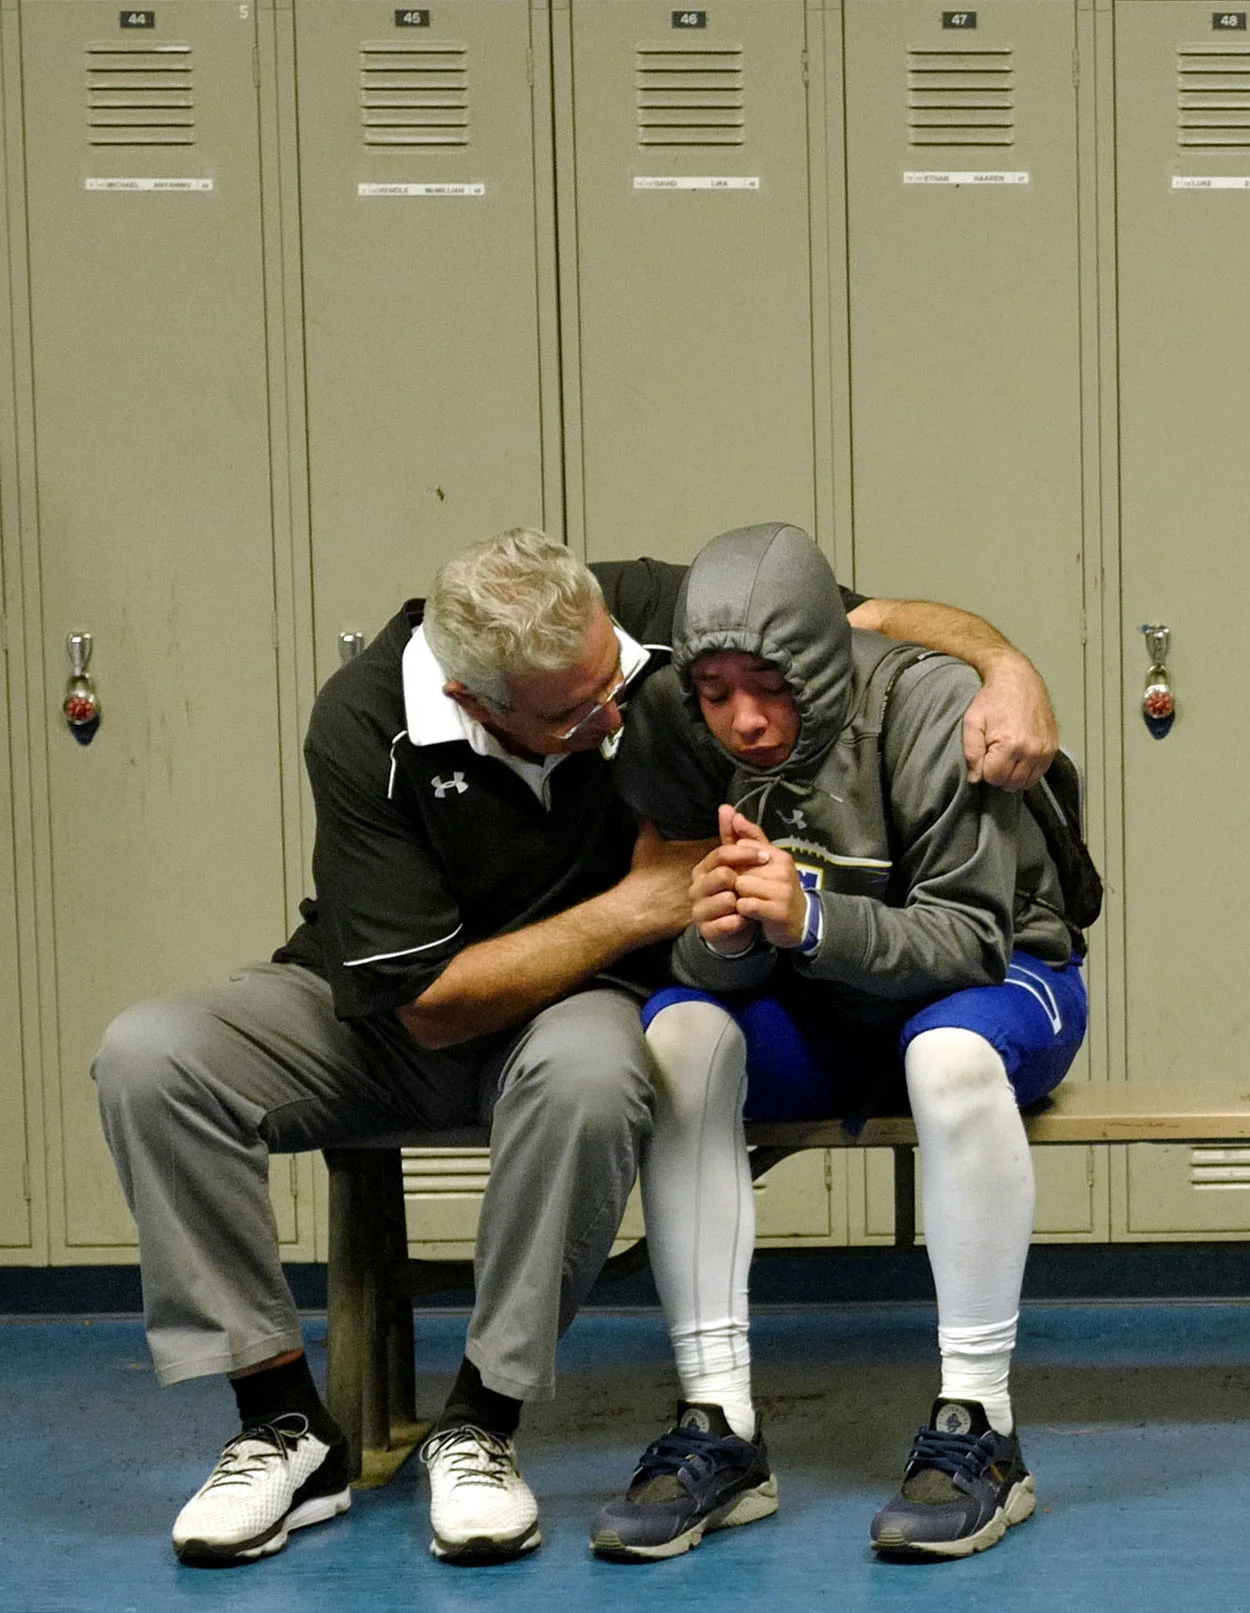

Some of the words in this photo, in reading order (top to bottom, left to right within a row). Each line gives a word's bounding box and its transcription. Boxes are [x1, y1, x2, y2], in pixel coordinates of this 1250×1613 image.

[128, 14, 145, 24] 44
[404, 12, 421, 23] 45
[680, 14, 697, 24] 46
[951, 15, 968, 24] 47
[1220, 15, 1237, 25] 48
